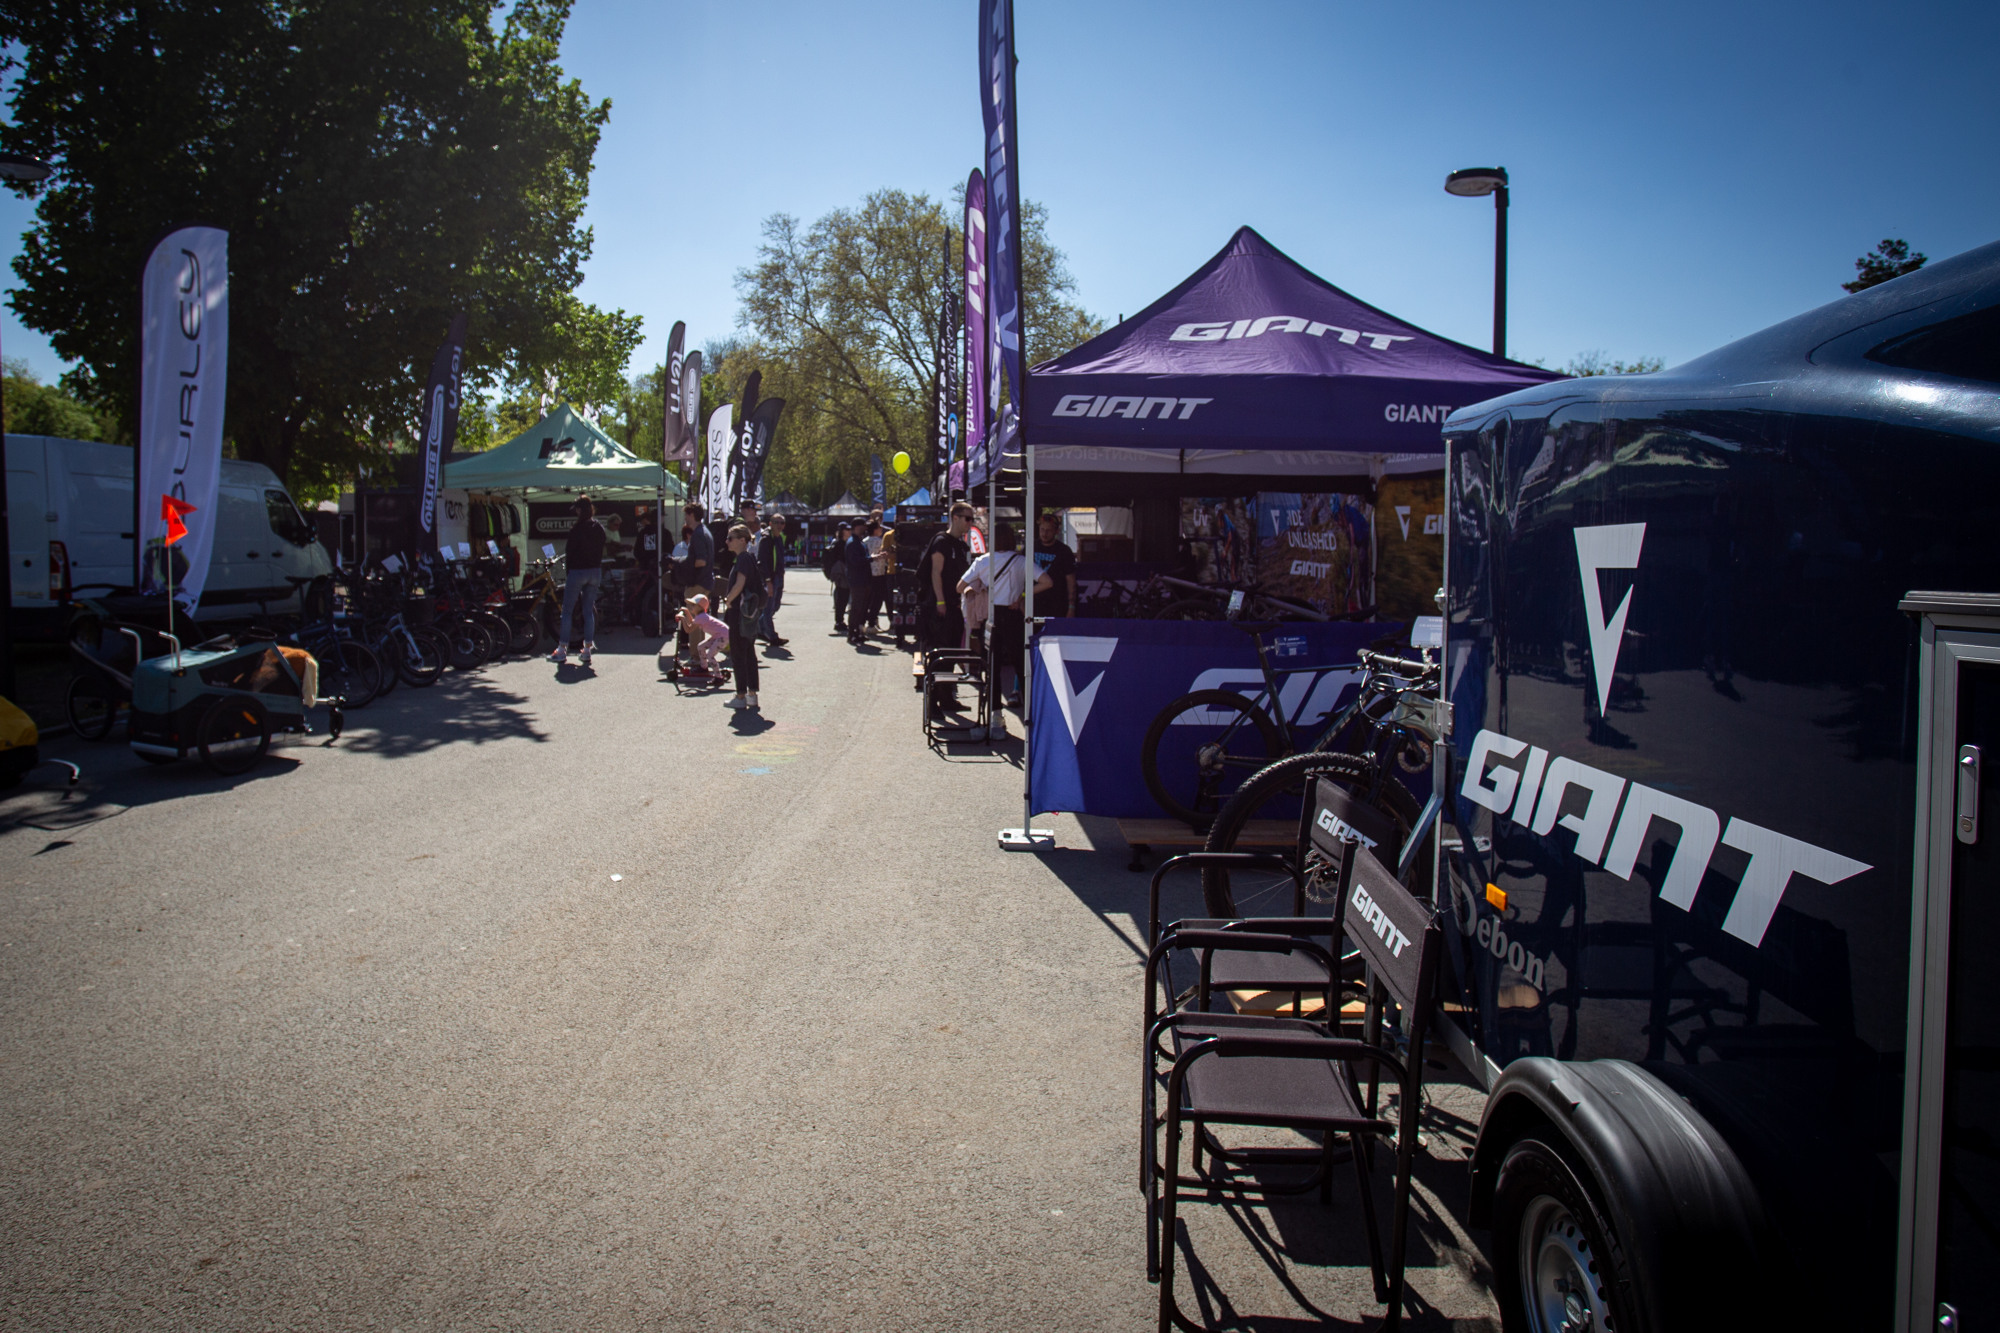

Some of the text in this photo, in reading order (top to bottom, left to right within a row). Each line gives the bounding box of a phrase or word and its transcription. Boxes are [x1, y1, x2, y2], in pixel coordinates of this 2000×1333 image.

[1169, 315, 1414, 351] GIANT
[1052, 394, 1214, 420] GIANT
[711, 429, 723, 511] ROOKS
[539, 520, 577, 530] ORTLIE
[1290, 560, 1331, 579] GIANT
[1303, 765, 1360, 777] MAXXIS
[1460, 729, 1875, 948] GIANT
[1351, 883, 1411, 959] GIANT
[1448, 855, 1544, 992] Debon
